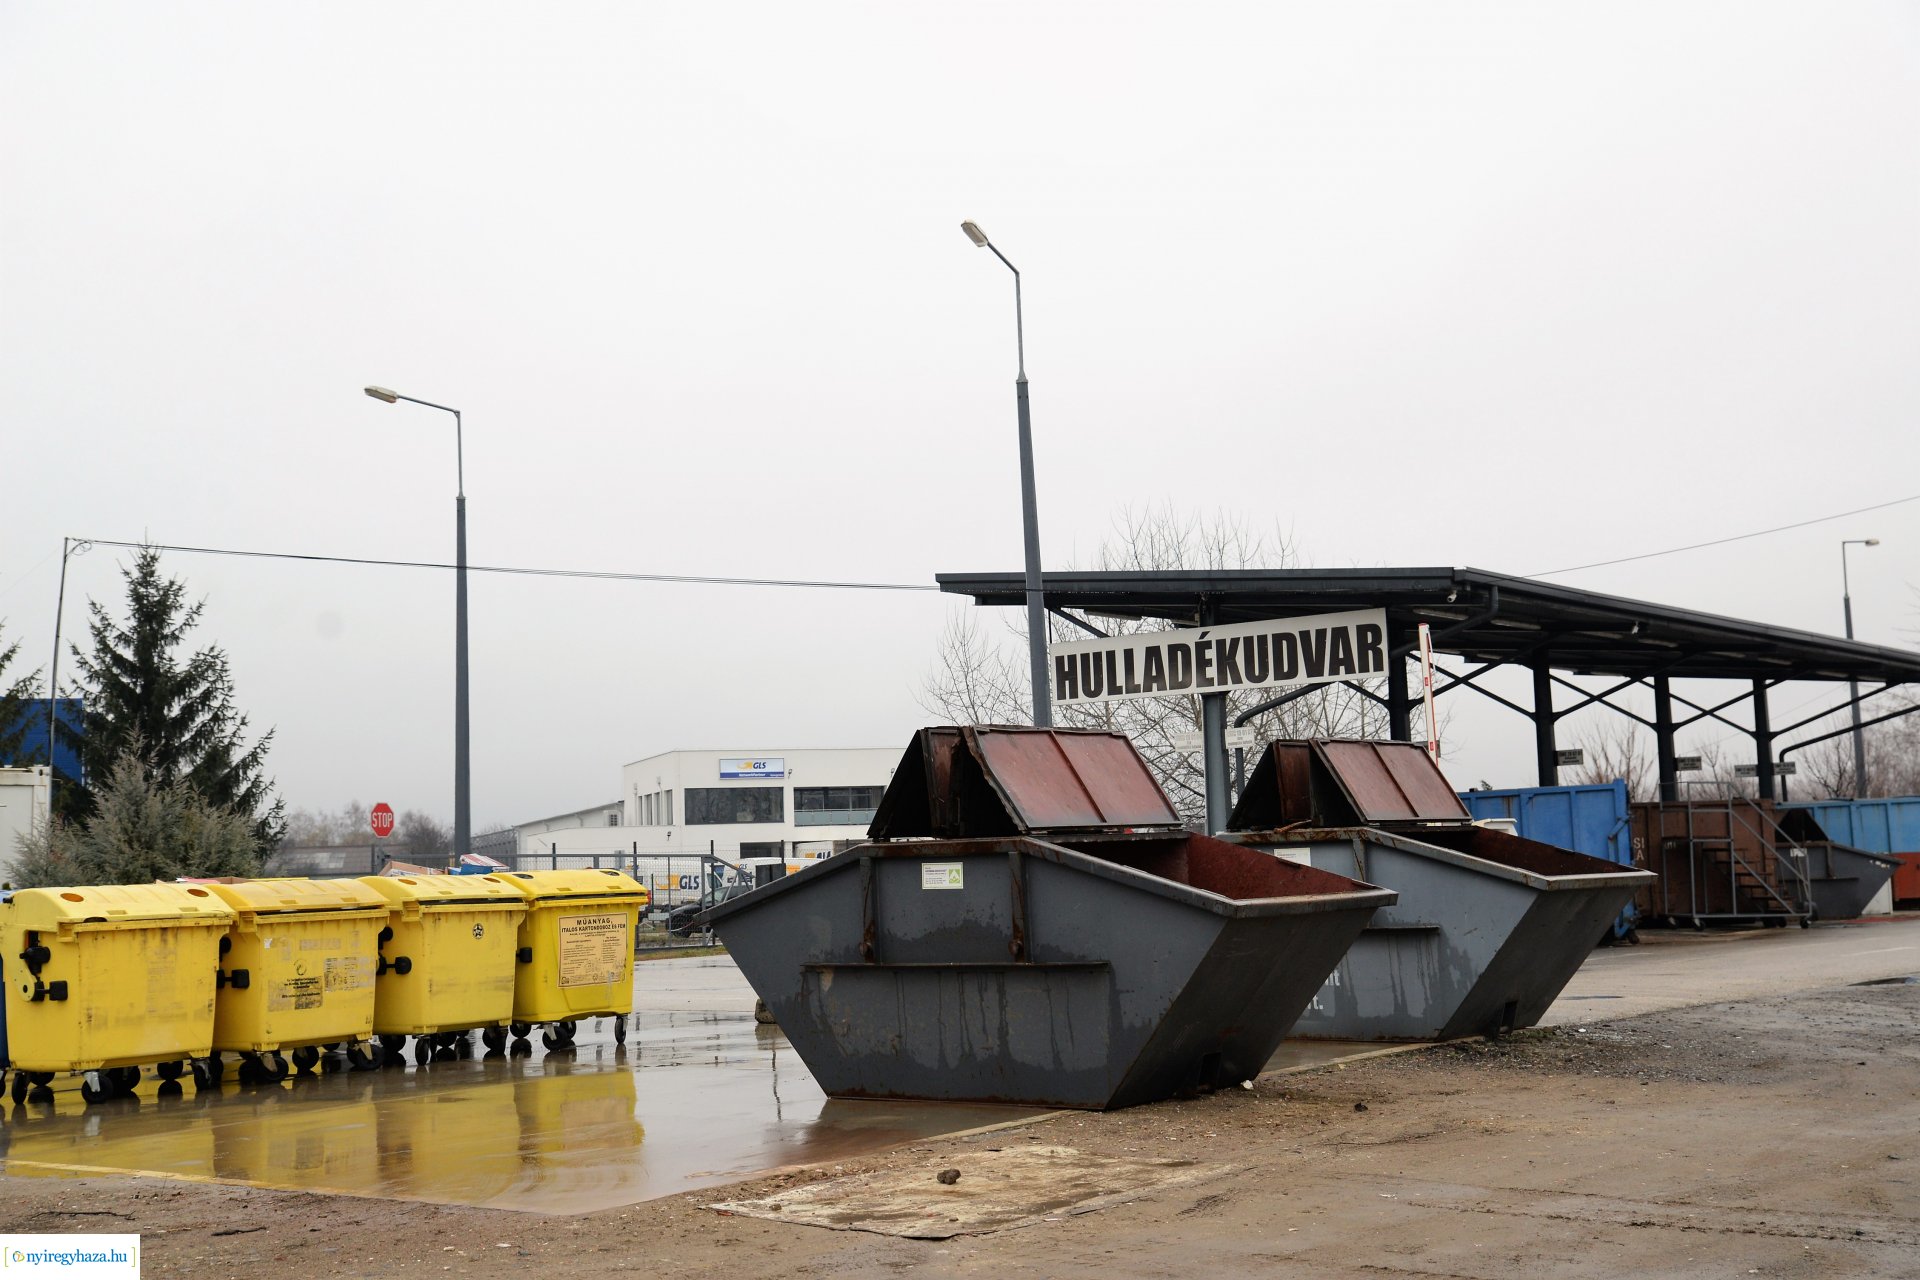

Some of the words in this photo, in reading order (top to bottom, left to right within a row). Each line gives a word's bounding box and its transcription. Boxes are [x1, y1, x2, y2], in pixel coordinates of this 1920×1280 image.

[1055, 623, 1384, 700] HULLADÉKUDVAR
[372, 812, 393, 828] STOP
[680, 875, 700, 890] GLS
